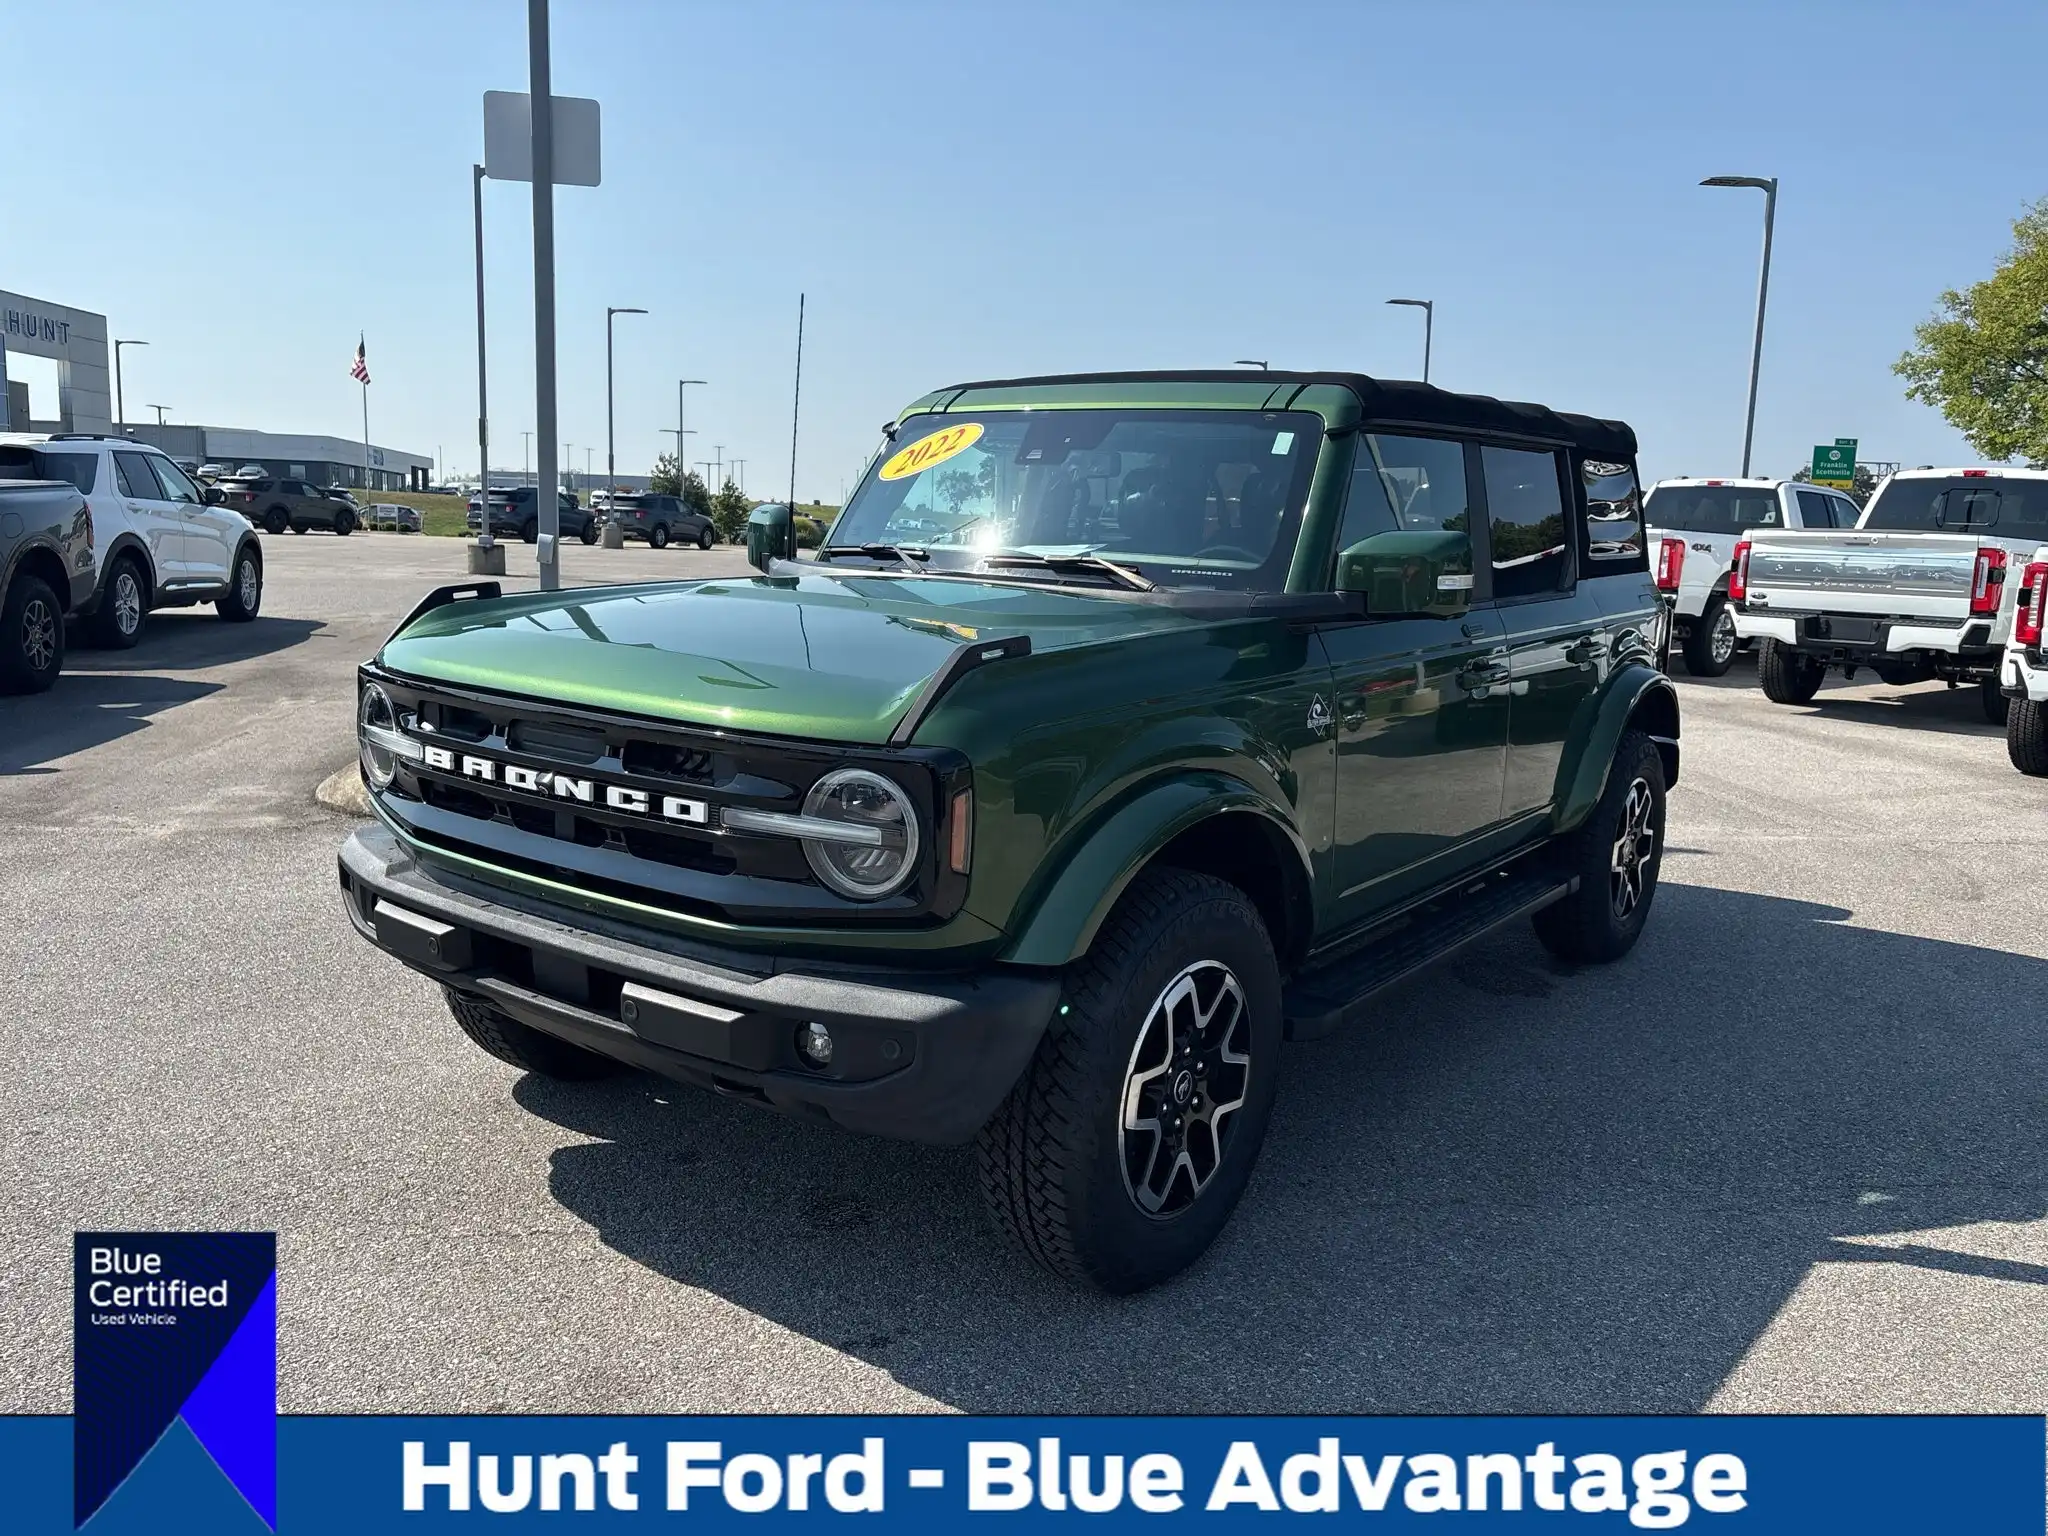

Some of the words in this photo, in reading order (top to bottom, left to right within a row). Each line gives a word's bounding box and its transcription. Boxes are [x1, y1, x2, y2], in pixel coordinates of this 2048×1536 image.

[8, 309, 70, 343] HUNT
[893, 428, 965, 475] 2022
[1815, 468, 1851, 476] Scottsville
[1171, 569, 1233, 577] BRONCO
[425, 746, 718, 823] BRONCO
